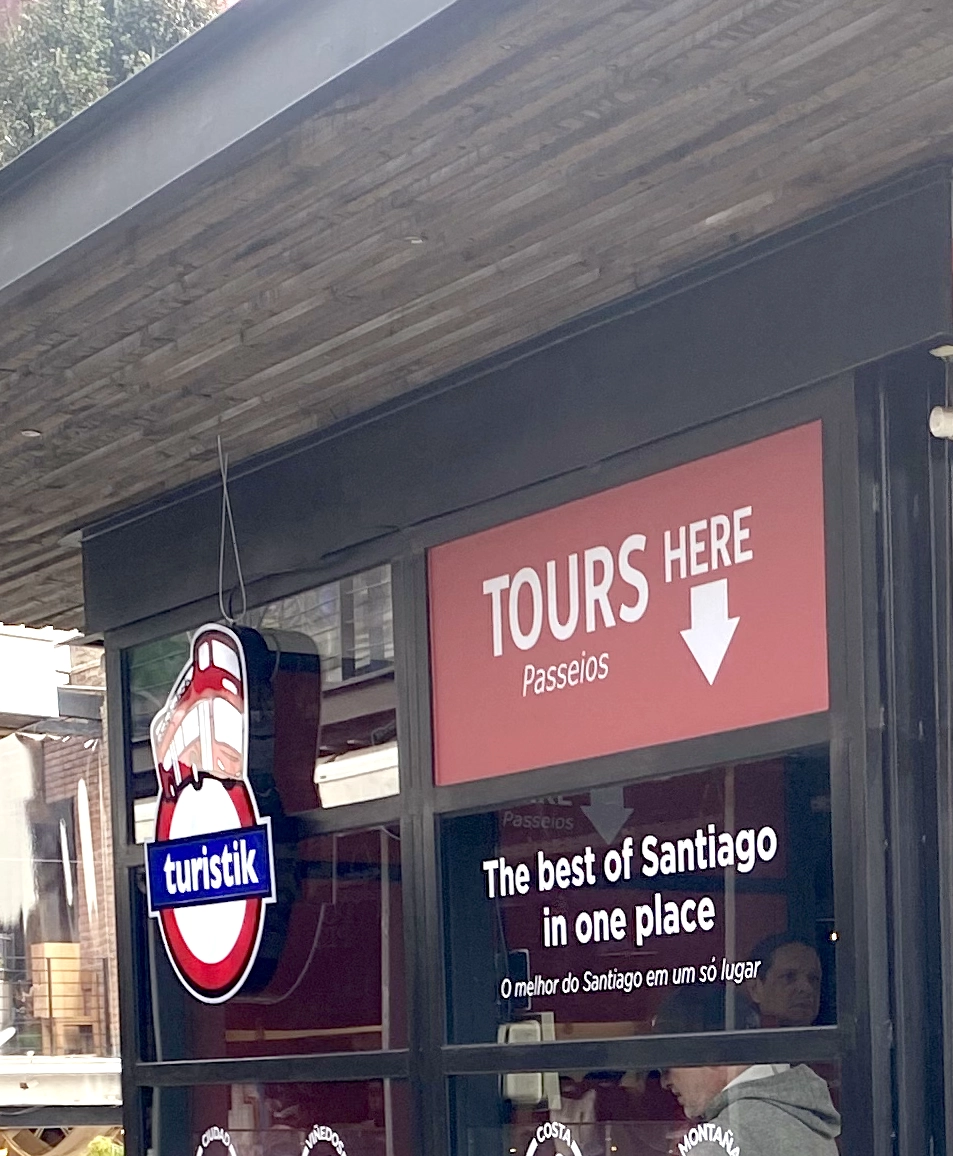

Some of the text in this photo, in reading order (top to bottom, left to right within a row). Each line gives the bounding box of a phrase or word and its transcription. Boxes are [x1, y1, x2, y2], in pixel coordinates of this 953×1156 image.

[482, 505, 753, 657] TOURS HERE
[522, 650, 610, 697] Passeios
[502, 810, 575, 831] Passeios
[163, 838, 259, 894] turistik
[482, 823, 778, 898] The best of Santiago
[543, 892, 716, 947] in one place
[500, 955, 762, 999] O melhor do Santiago em um só lugar
[305, 1124, 345, 1155] VIÑEDOS
[536, 1121, 572, 1148] COSTA
